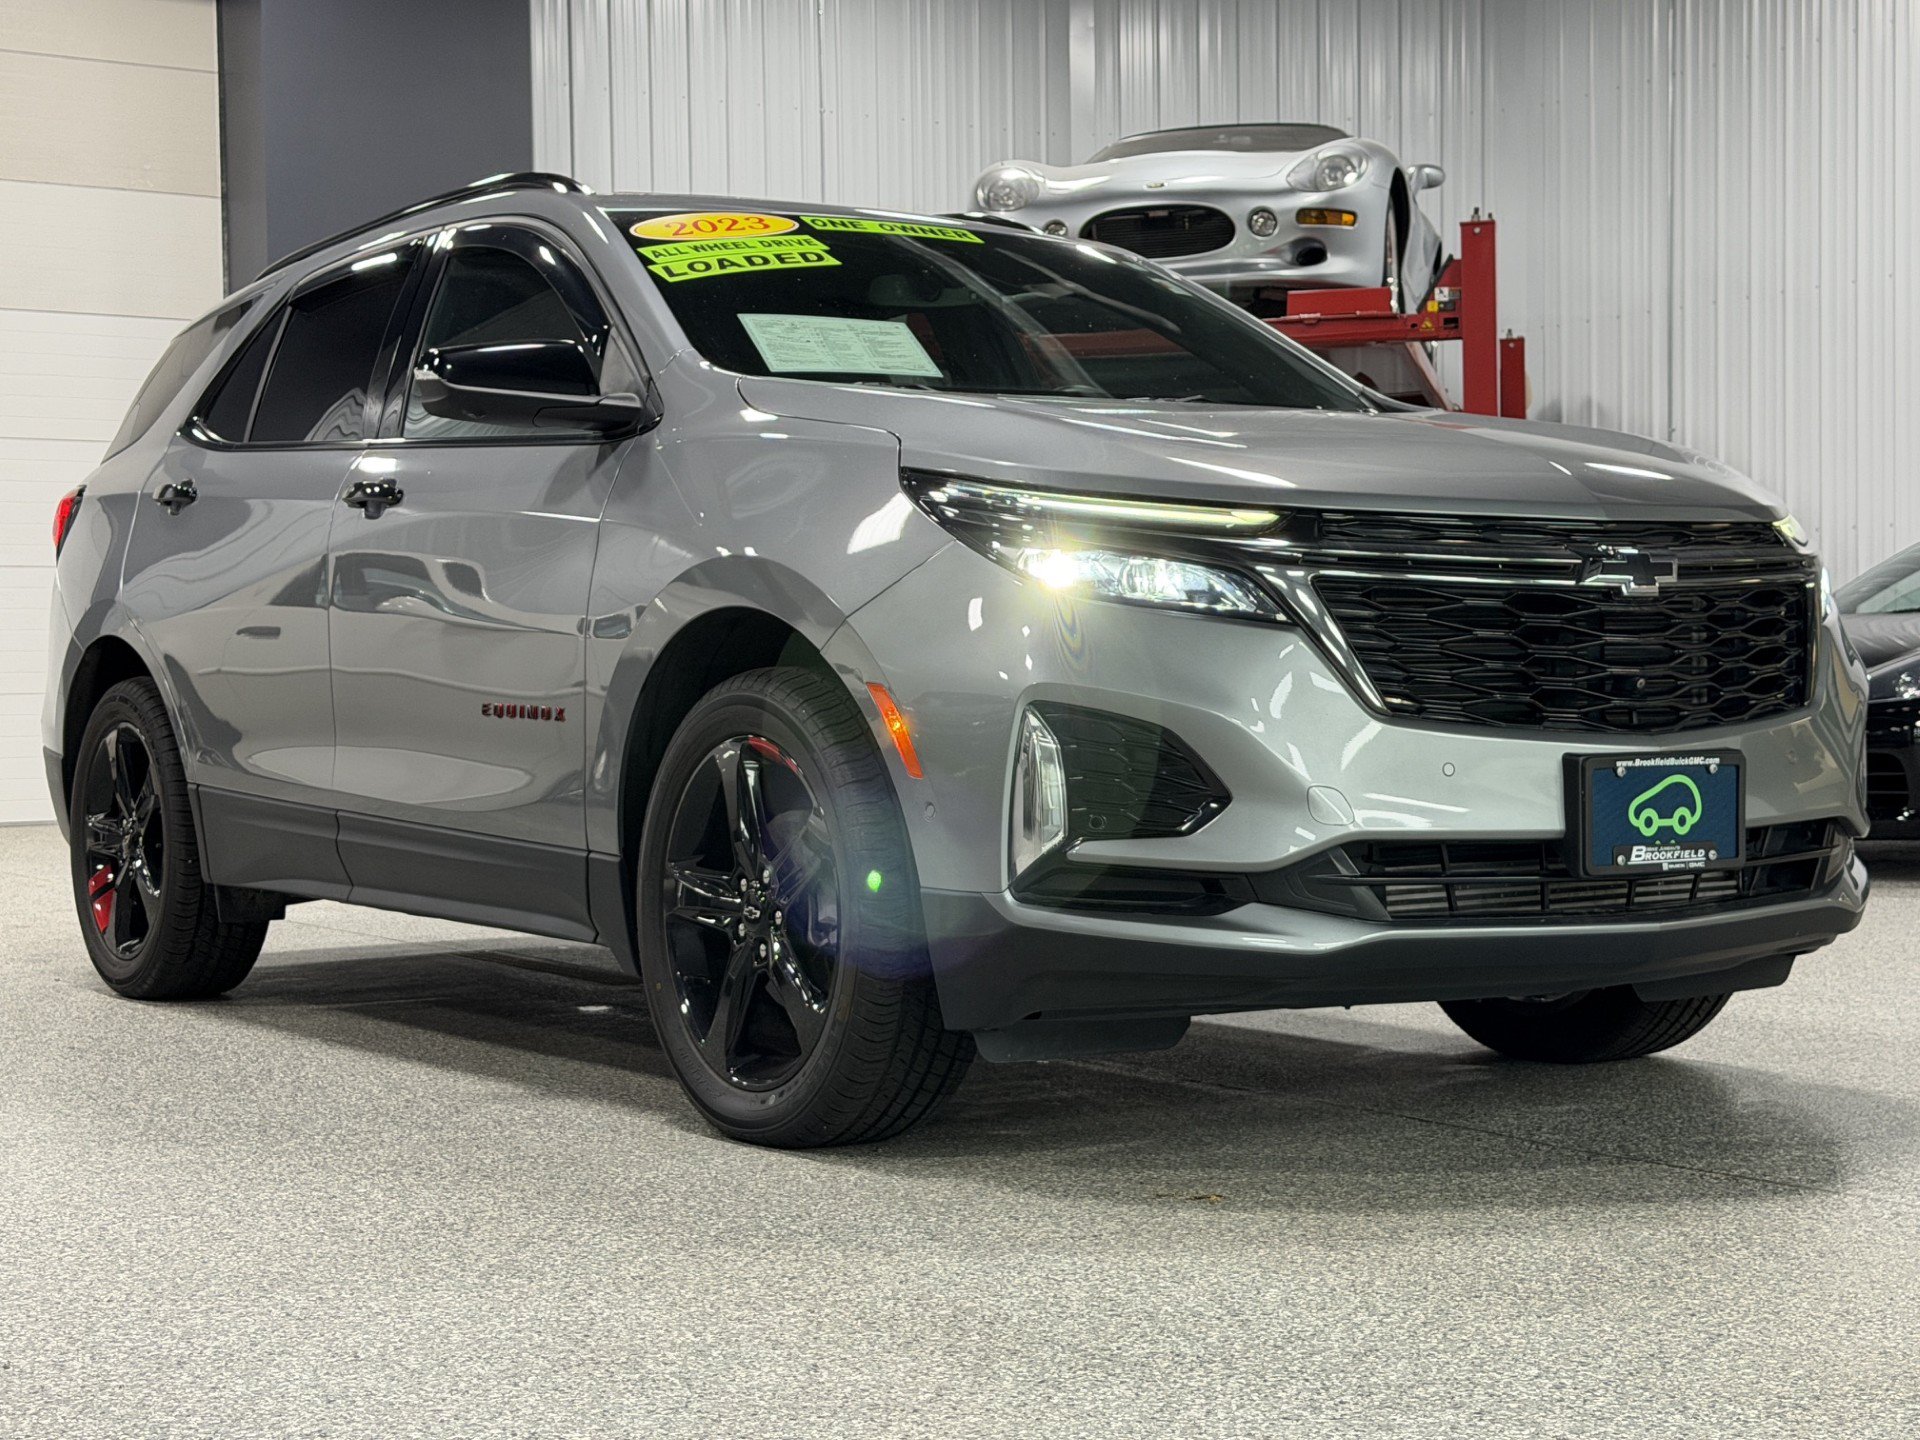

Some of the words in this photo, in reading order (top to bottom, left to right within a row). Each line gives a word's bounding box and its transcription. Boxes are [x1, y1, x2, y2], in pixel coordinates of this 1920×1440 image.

[665, 216, 770, 236] 2023
[810, 218, 867, 230] ONE
[878, 222, 978, 240] OWNER
[651, 247, 689, 259] ALL
[688, 240, 758, 254] WHEEL
[759, 237, 818, 249] DRIVE
[661, 250, 827, 278] LOADED
[482, 703, 566, 722] EQUINOX
[1616, 757, 1720, 767] www.BrookfieldBuickGMC.com
